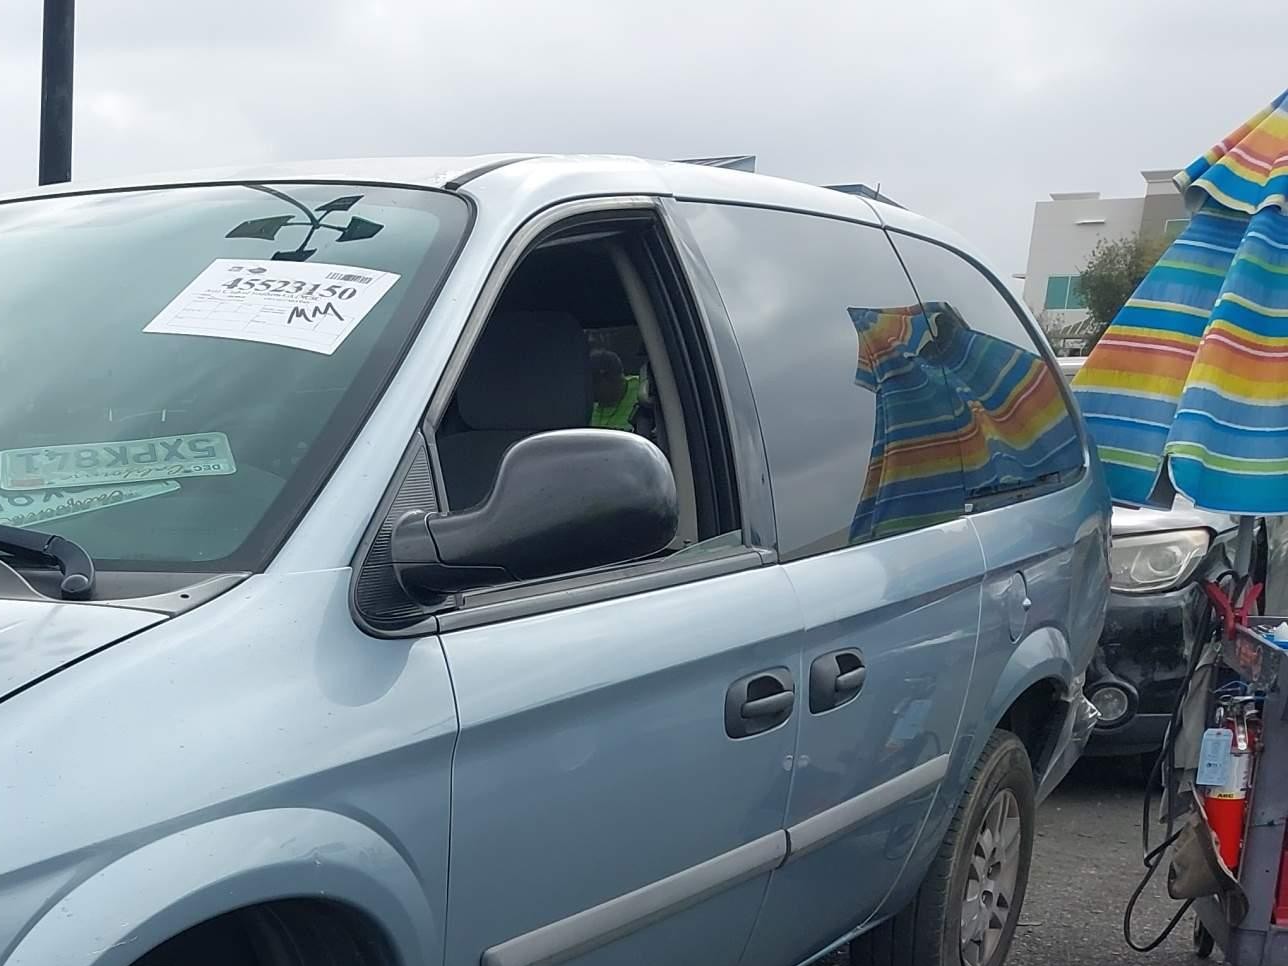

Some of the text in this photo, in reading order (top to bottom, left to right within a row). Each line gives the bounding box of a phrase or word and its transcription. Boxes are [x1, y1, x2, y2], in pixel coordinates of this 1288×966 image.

[222, 276, 358, 302] 45523150
[16, 437, 218, 474] 5XPK841
[192, 463, 221, 473] DEC
